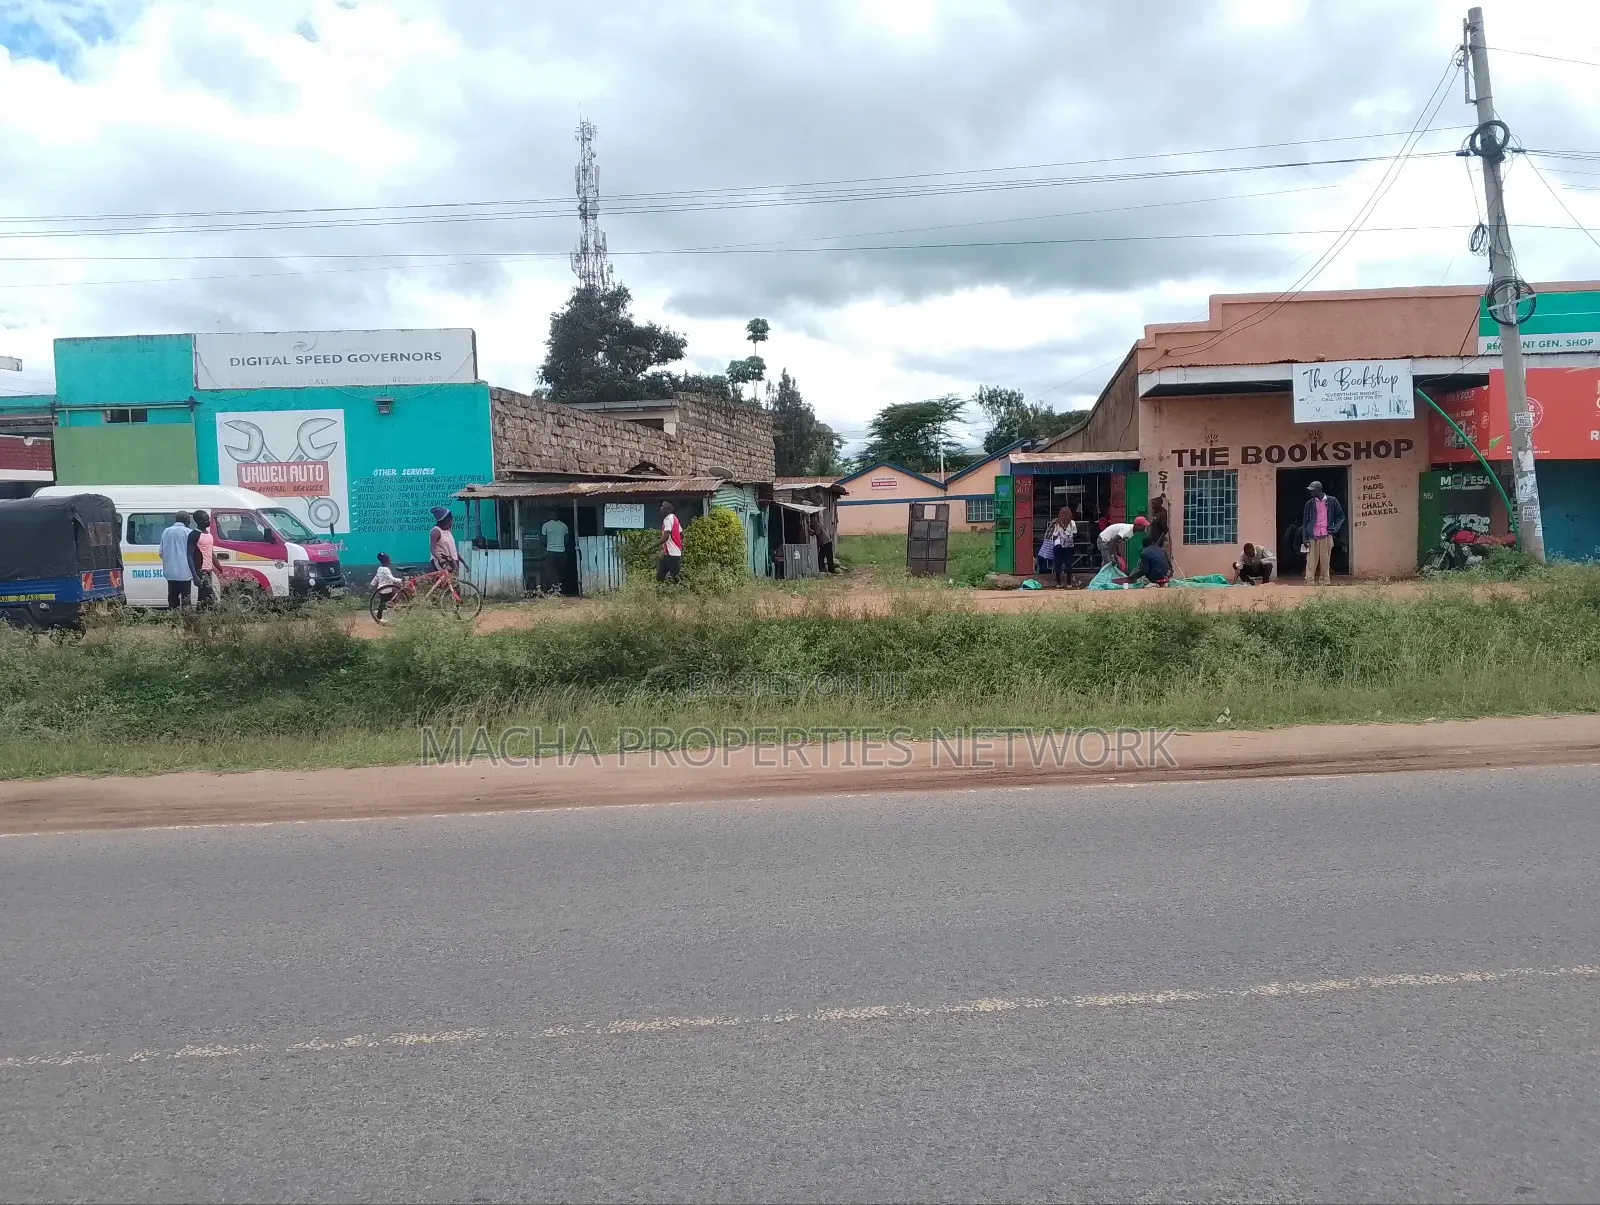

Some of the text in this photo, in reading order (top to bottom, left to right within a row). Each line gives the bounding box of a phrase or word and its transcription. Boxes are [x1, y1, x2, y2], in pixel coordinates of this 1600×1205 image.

[1538, 339, 1562, 348] GEN.
[1566, 338, 1594, 347] SHOP
[230, 352, 442, 366] DIGITAL SPEED GOVERNORS
[1303, 364, 1398, 394] The Bookshop
[1171, 438, 1414, 468] THE BOOKSHOP
[241, 464, 324, 484] UKWELI AUTO
[373, 468, 436, 476] OTHER SERVICES
[1362, 474, 1380, 482] PENS
[1363, 483, 1384, 492] PADS
[396, 492, 419, 500] SPRAY
[1362, 492, 1387, 500] FILES
[1362, 500, 1394, 510] CHALKS
[1362, 508, 1398, 518] MARKERS
[358, 516, 402, 525] BREAKDOWN
[1354, 520, 1368, 528] ETC
[398, 524, 406, 532] OF
